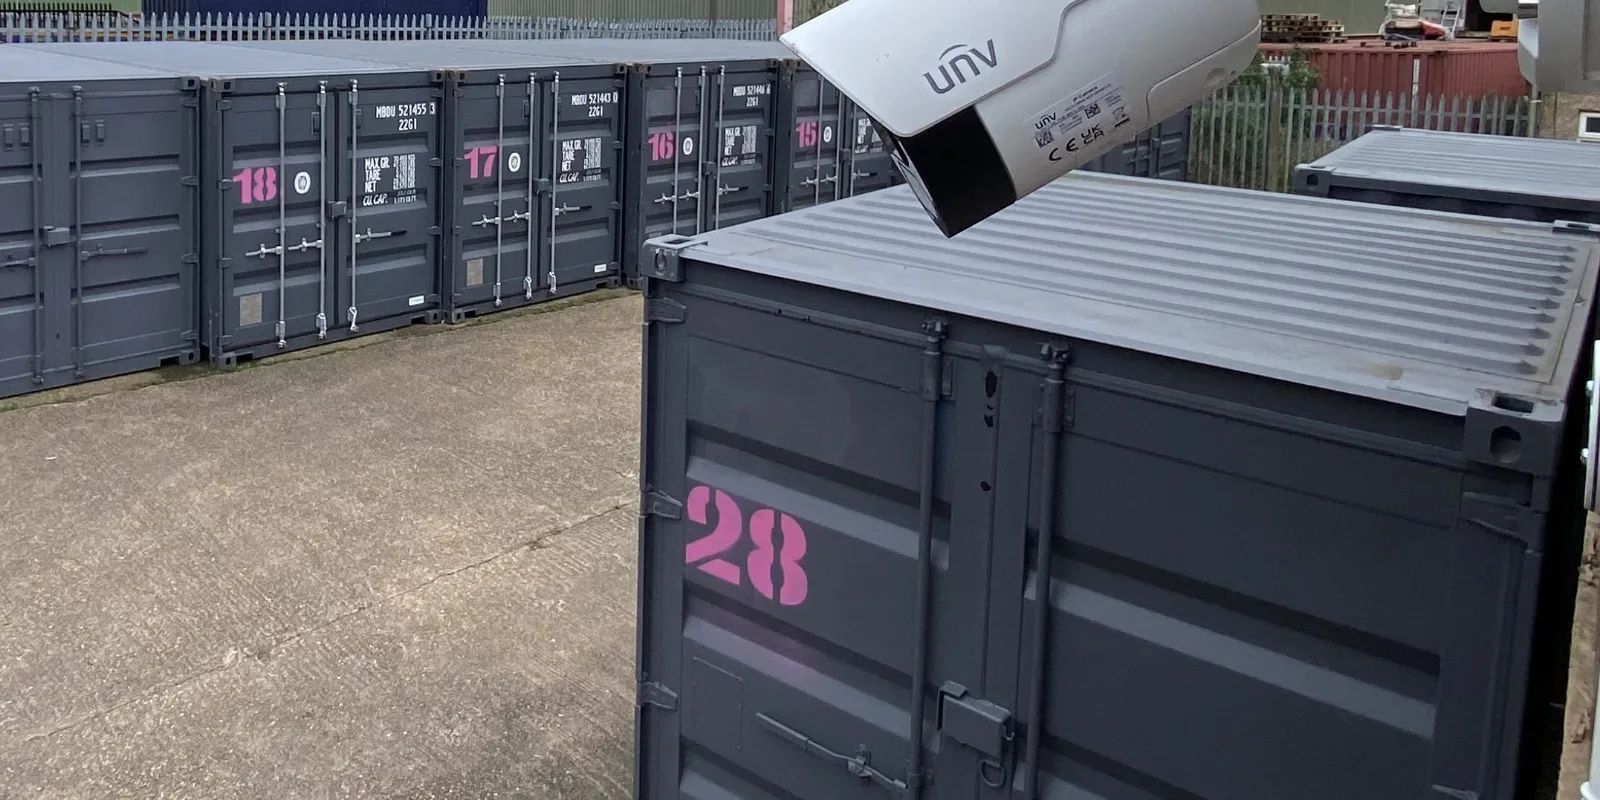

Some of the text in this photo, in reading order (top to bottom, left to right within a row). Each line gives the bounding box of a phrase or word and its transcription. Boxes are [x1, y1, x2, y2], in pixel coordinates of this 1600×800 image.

[922, 39, 997, 94] unv
[398, 103, 427, 117] 521455
[429, 102, 436, 115] 3
[588, 92, 611, 105] 521443
[648, 132, 674, 161] 16
[796, 121, 817, 148] 15
[365, 168, 381, 181] TARE
[464, 145, 498, 179] 17
[233, 167, 277, 204] 18
[365, 180, 377, 193] NET
[686, 485, 808, 605] 28
